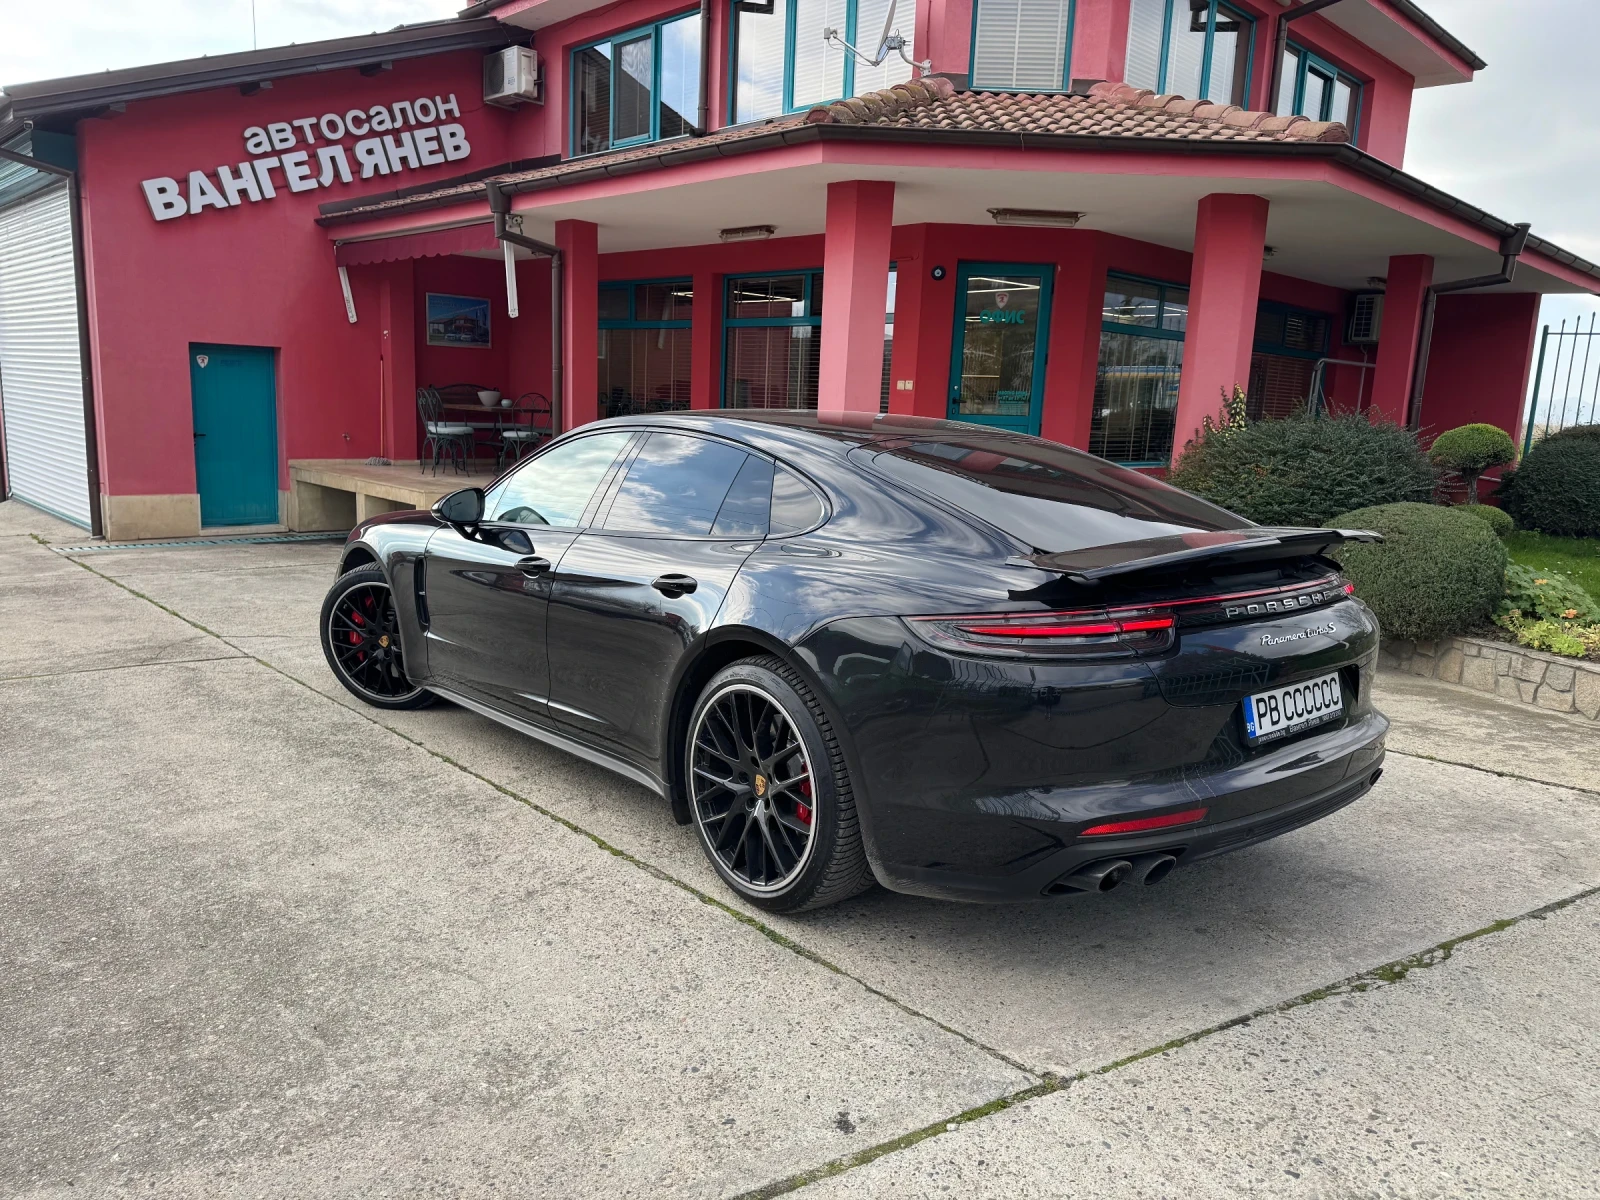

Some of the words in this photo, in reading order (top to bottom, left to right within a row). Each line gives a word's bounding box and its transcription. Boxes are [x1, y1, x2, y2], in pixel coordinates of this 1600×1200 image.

[244, 93, 460, 155] автосалон
[140, 144, 353, 221] ВАНГЕЛ
[353, 123, 471, 179] ЯНЕВ
[980, 309, 1026, 324] ОФИС
[1225, 591, 1331, 618] PORSCHE
[1261, 632, 1306, 646] Panamera
